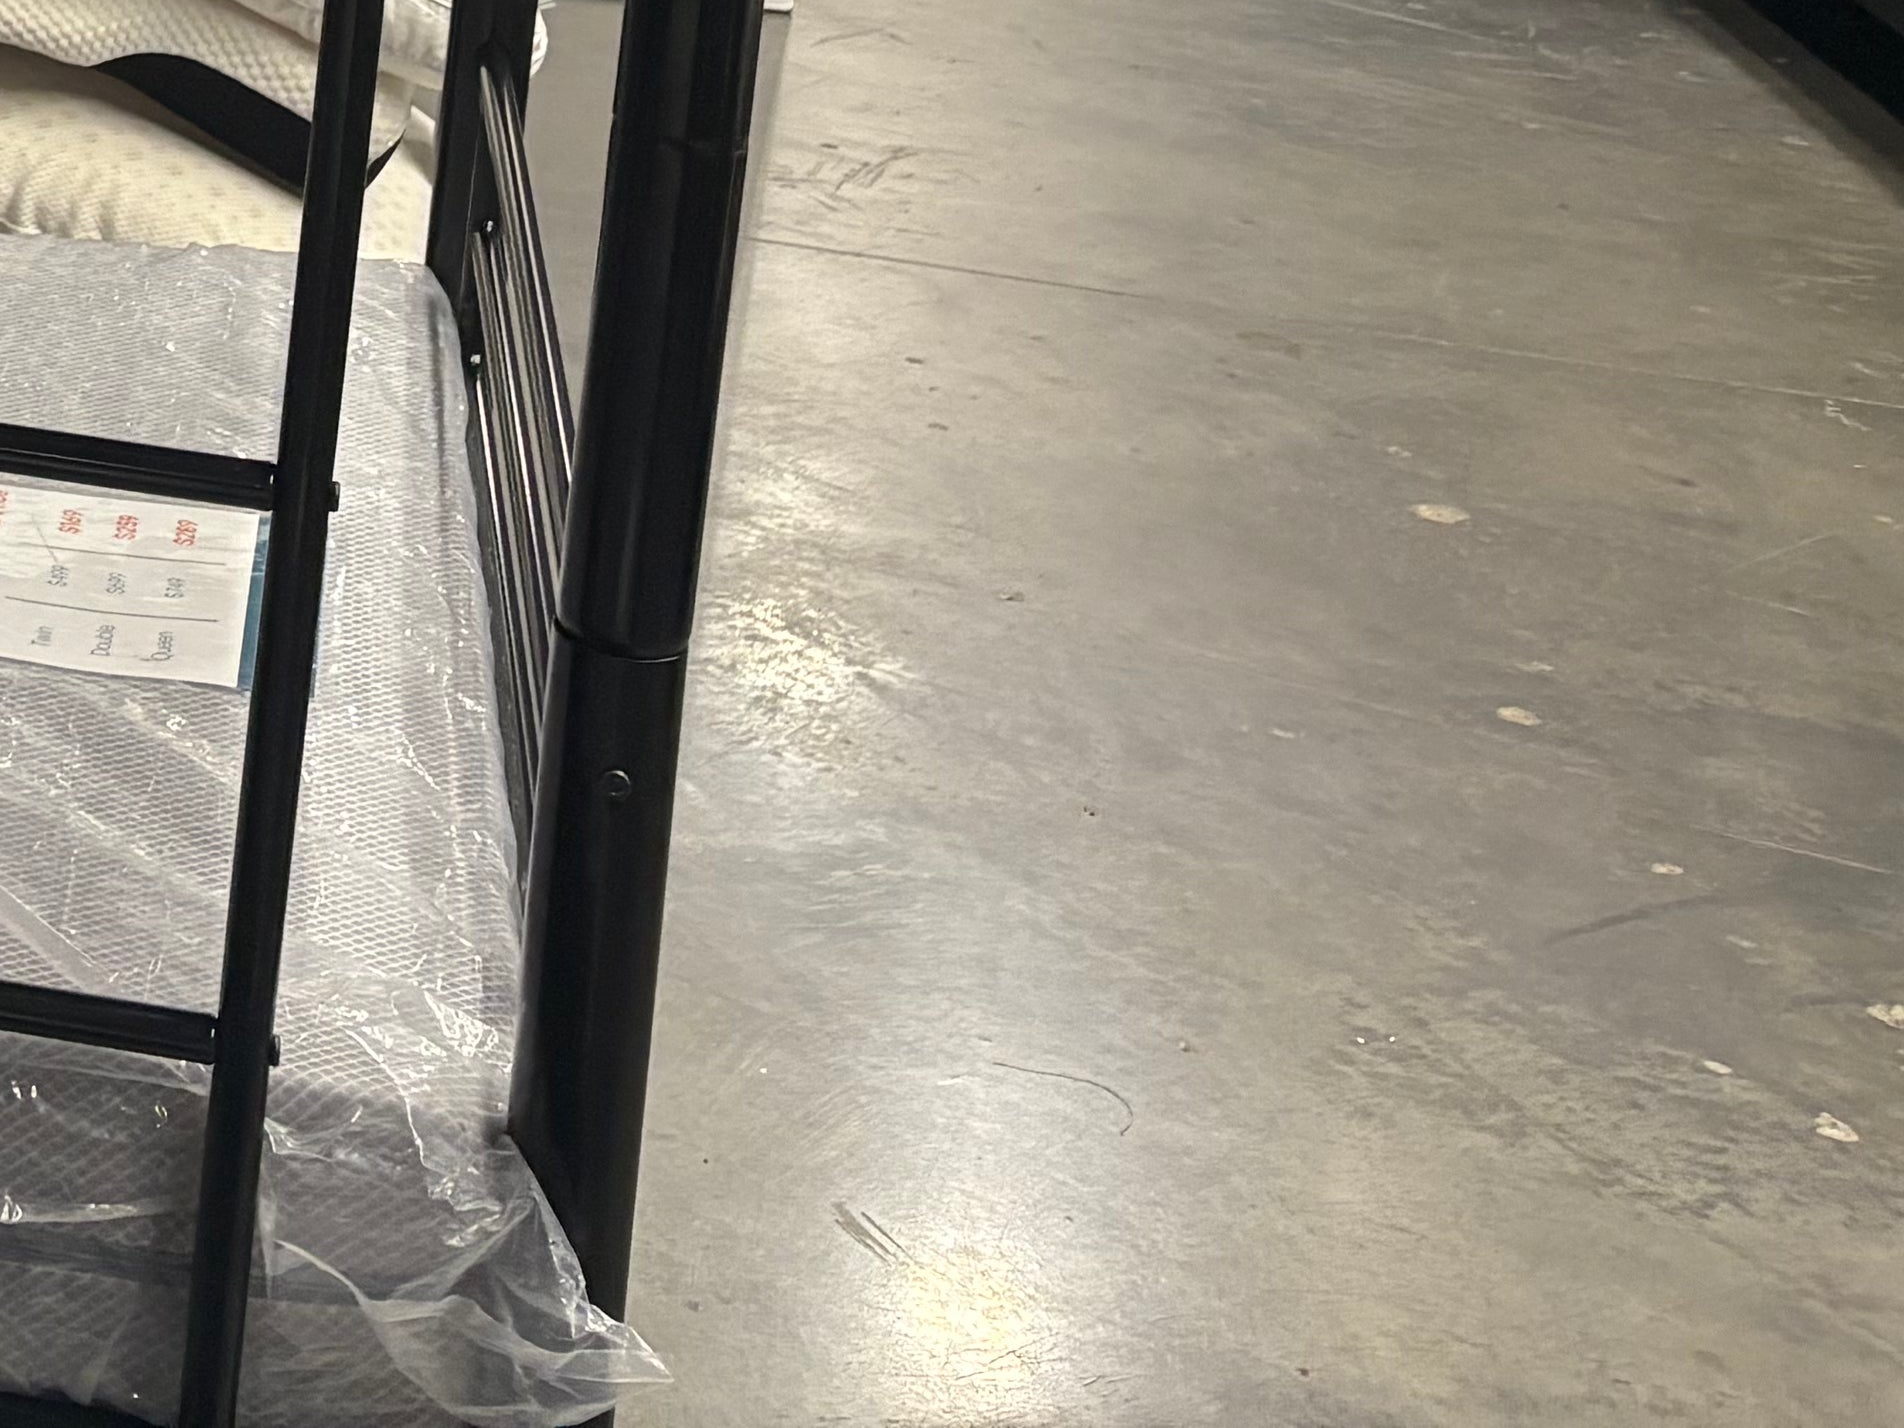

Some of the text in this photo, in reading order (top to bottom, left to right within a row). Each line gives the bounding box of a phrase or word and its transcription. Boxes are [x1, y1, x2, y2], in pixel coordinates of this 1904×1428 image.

[30, 625, 54, 646] Twin
[58, 508, 84, 535] $169
[90, 624, 115, 657] Double
[114, 514, 140, 541] $259
[149, 630, 175, 661] Queen
[172, 519, 199, 547] $289
